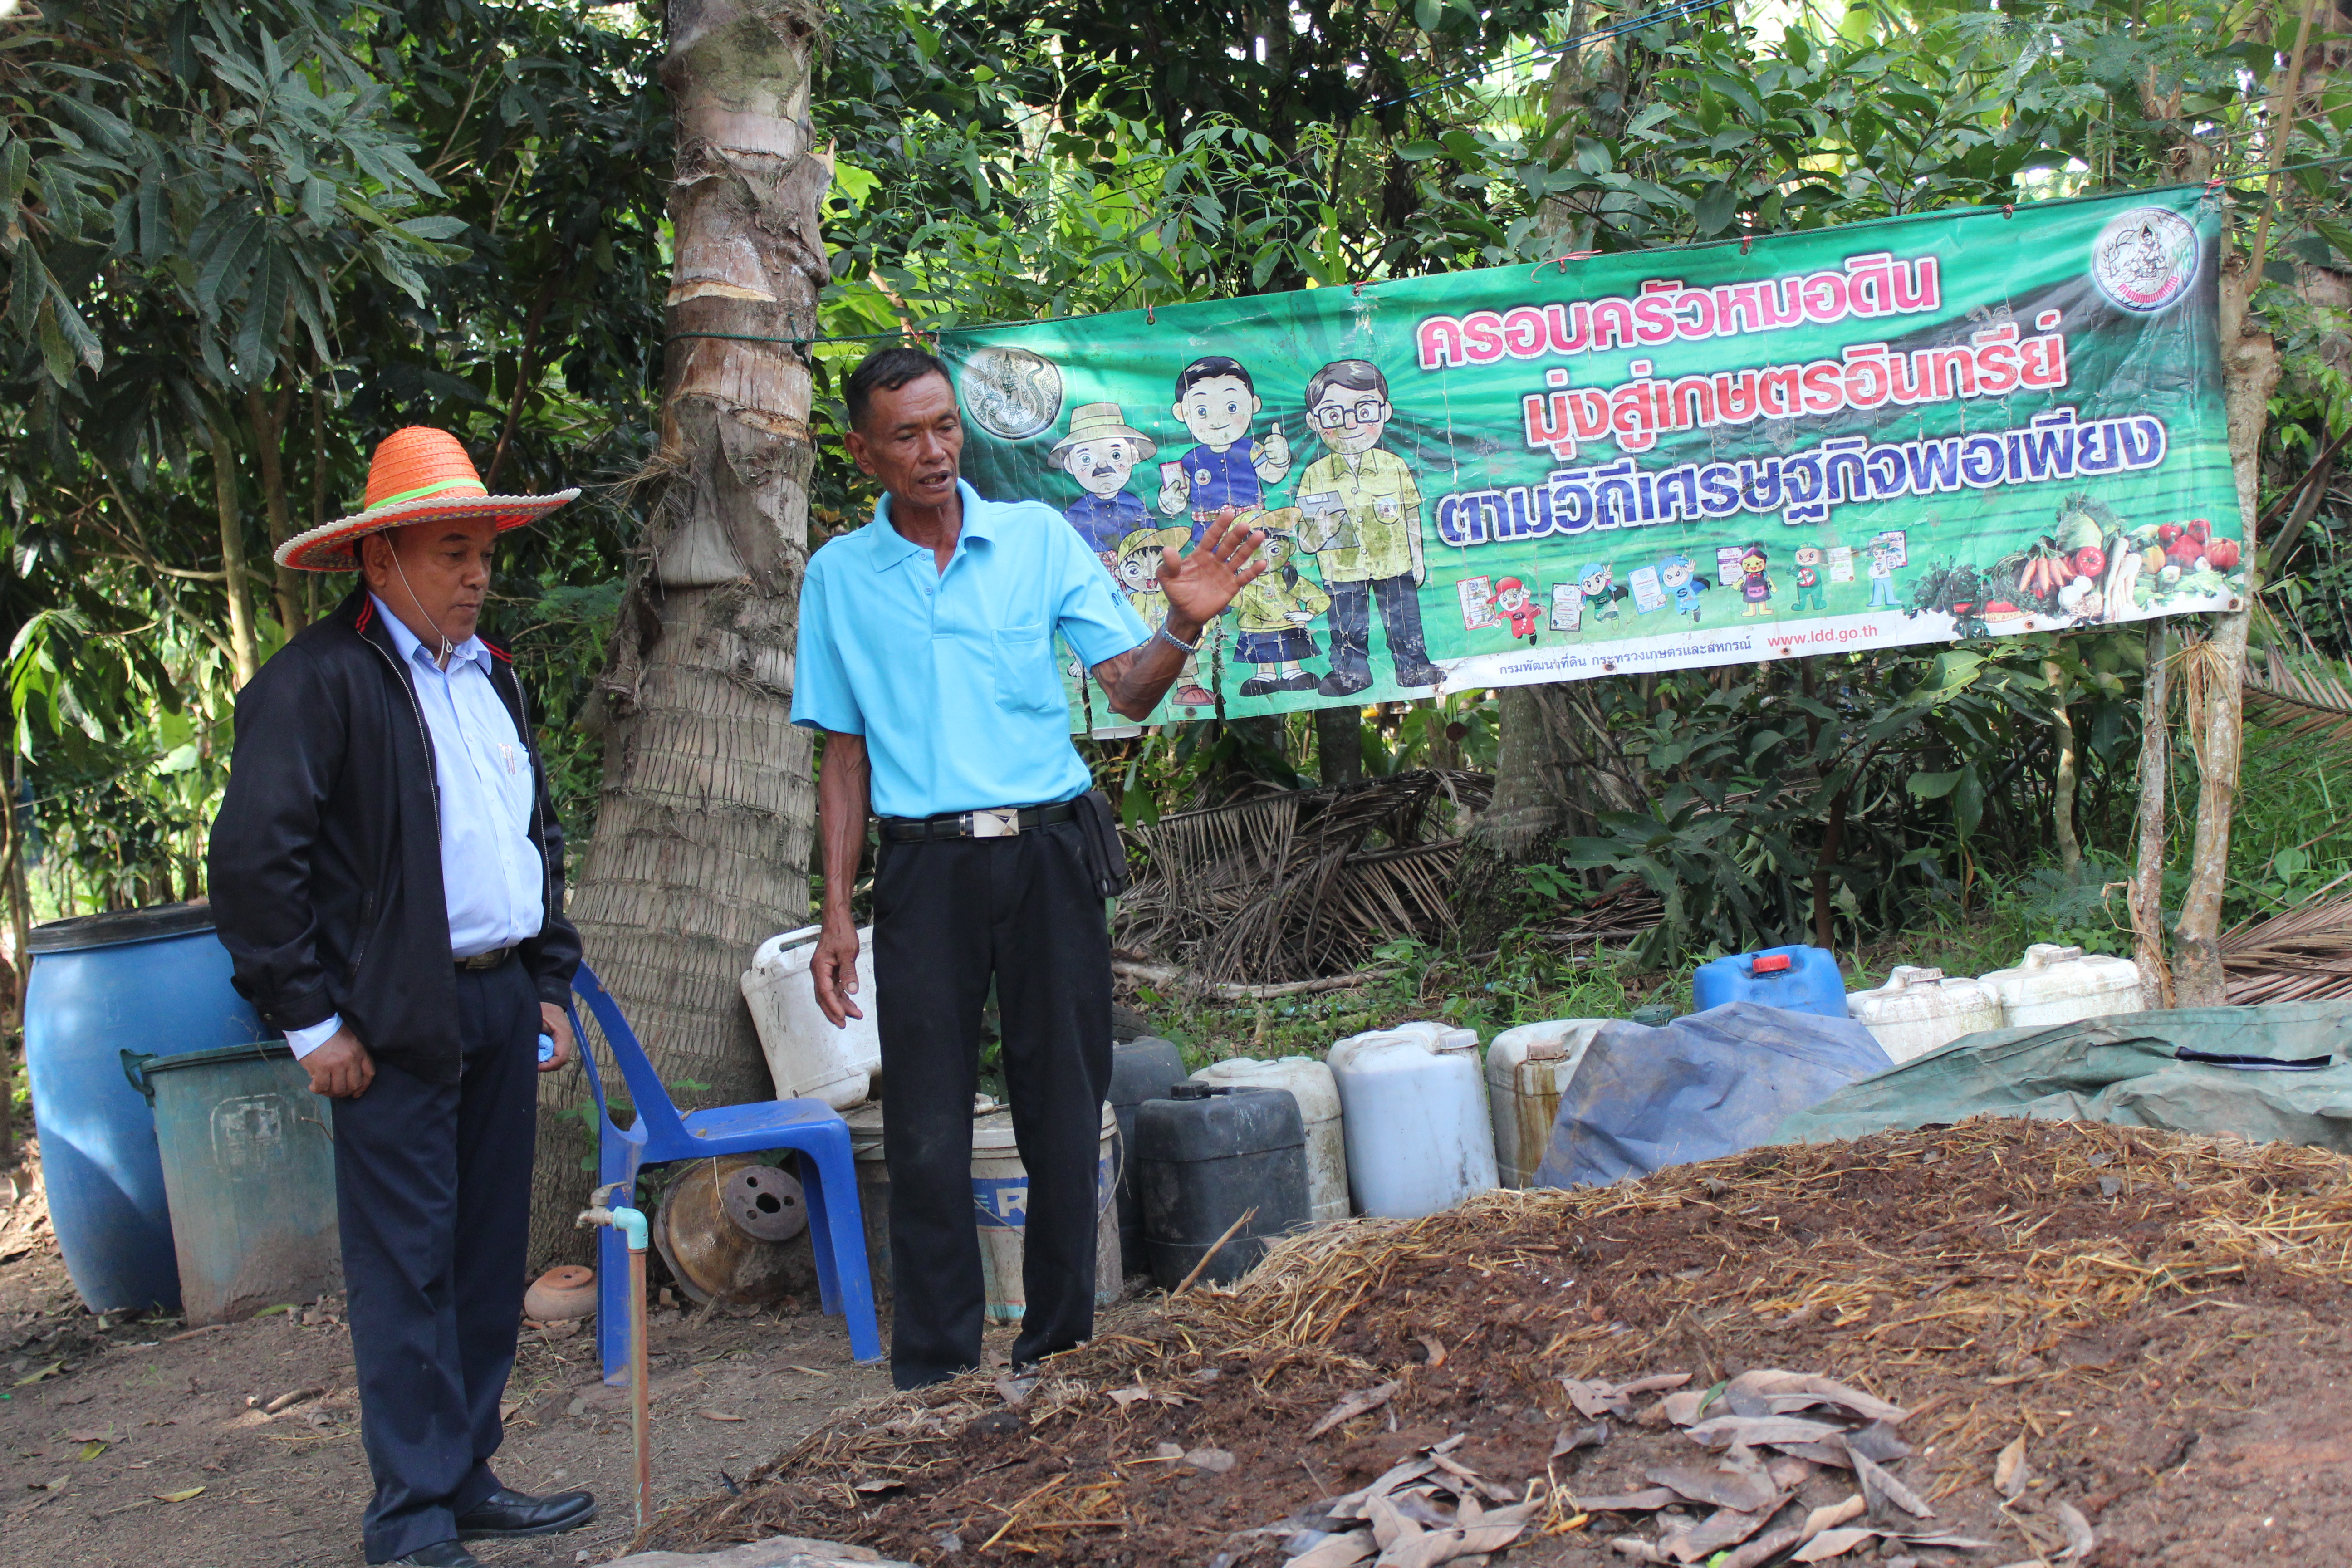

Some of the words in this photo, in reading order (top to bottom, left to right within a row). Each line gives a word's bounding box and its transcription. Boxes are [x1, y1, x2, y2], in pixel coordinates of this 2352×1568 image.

[1419, 257, 1940, 369] ครอบครัวหมอดิน
[1525, 313, 2065, 454] มุ่งสู่เกษตรอินทรีย์
[1440, 413, 2164, 544] ตามวิถีเศรษฐกิจพอเพียง
[1499, 653, 1588, 675] กรมพัฒนาที่ดิน
[1768, 624, 1878, 648] www.ldd.go.th
